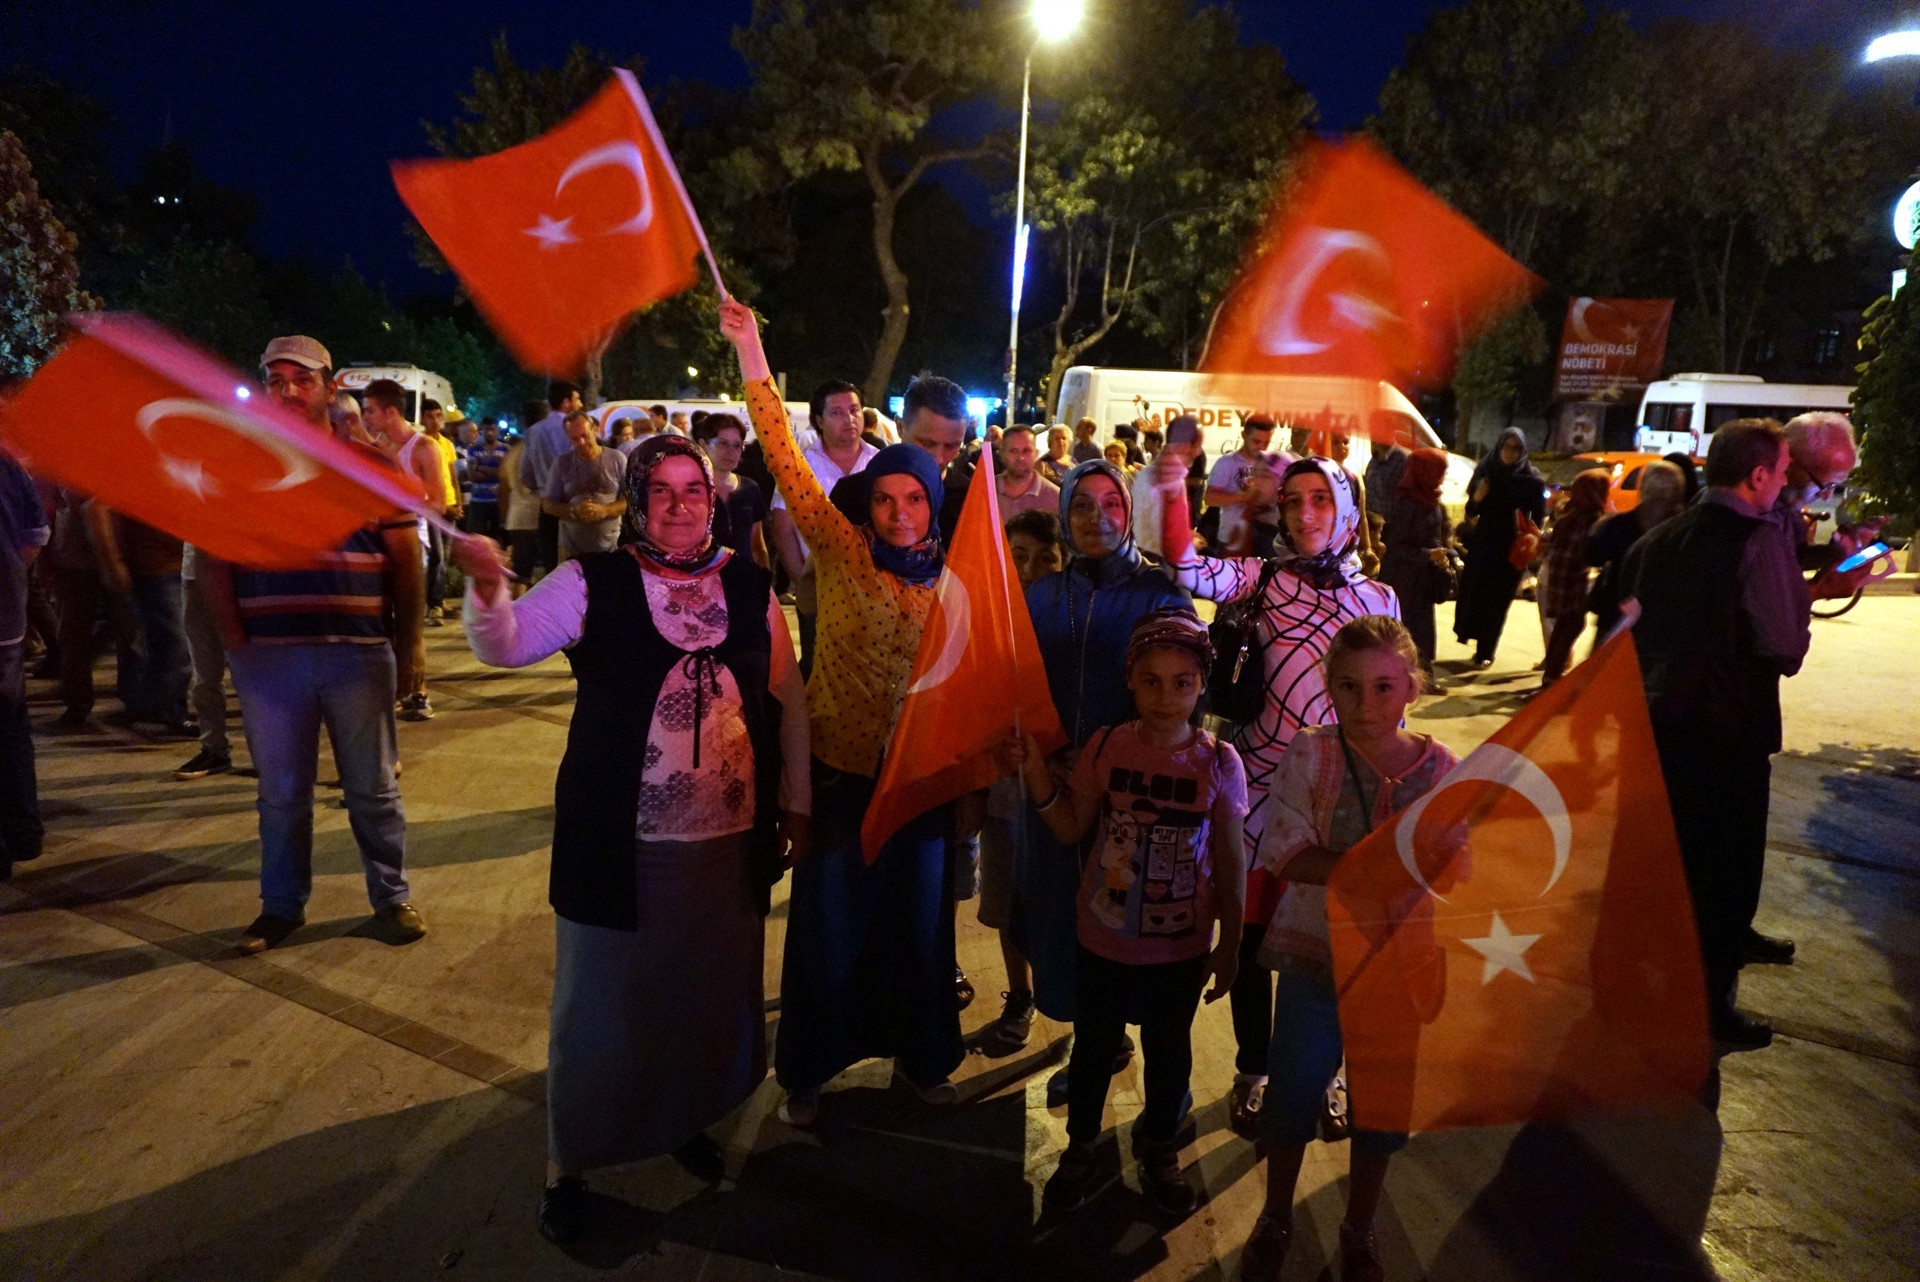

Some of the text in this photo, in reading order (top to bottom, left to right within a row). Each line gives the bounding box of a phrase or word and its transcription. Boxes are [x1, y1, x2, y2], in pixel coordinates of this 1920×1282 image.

[1565, 342, 1638, 355] DEMOKRASİ
[1562, 355, 1607, 369] NÖBETİ
[349, 373, 370, 381] 112
